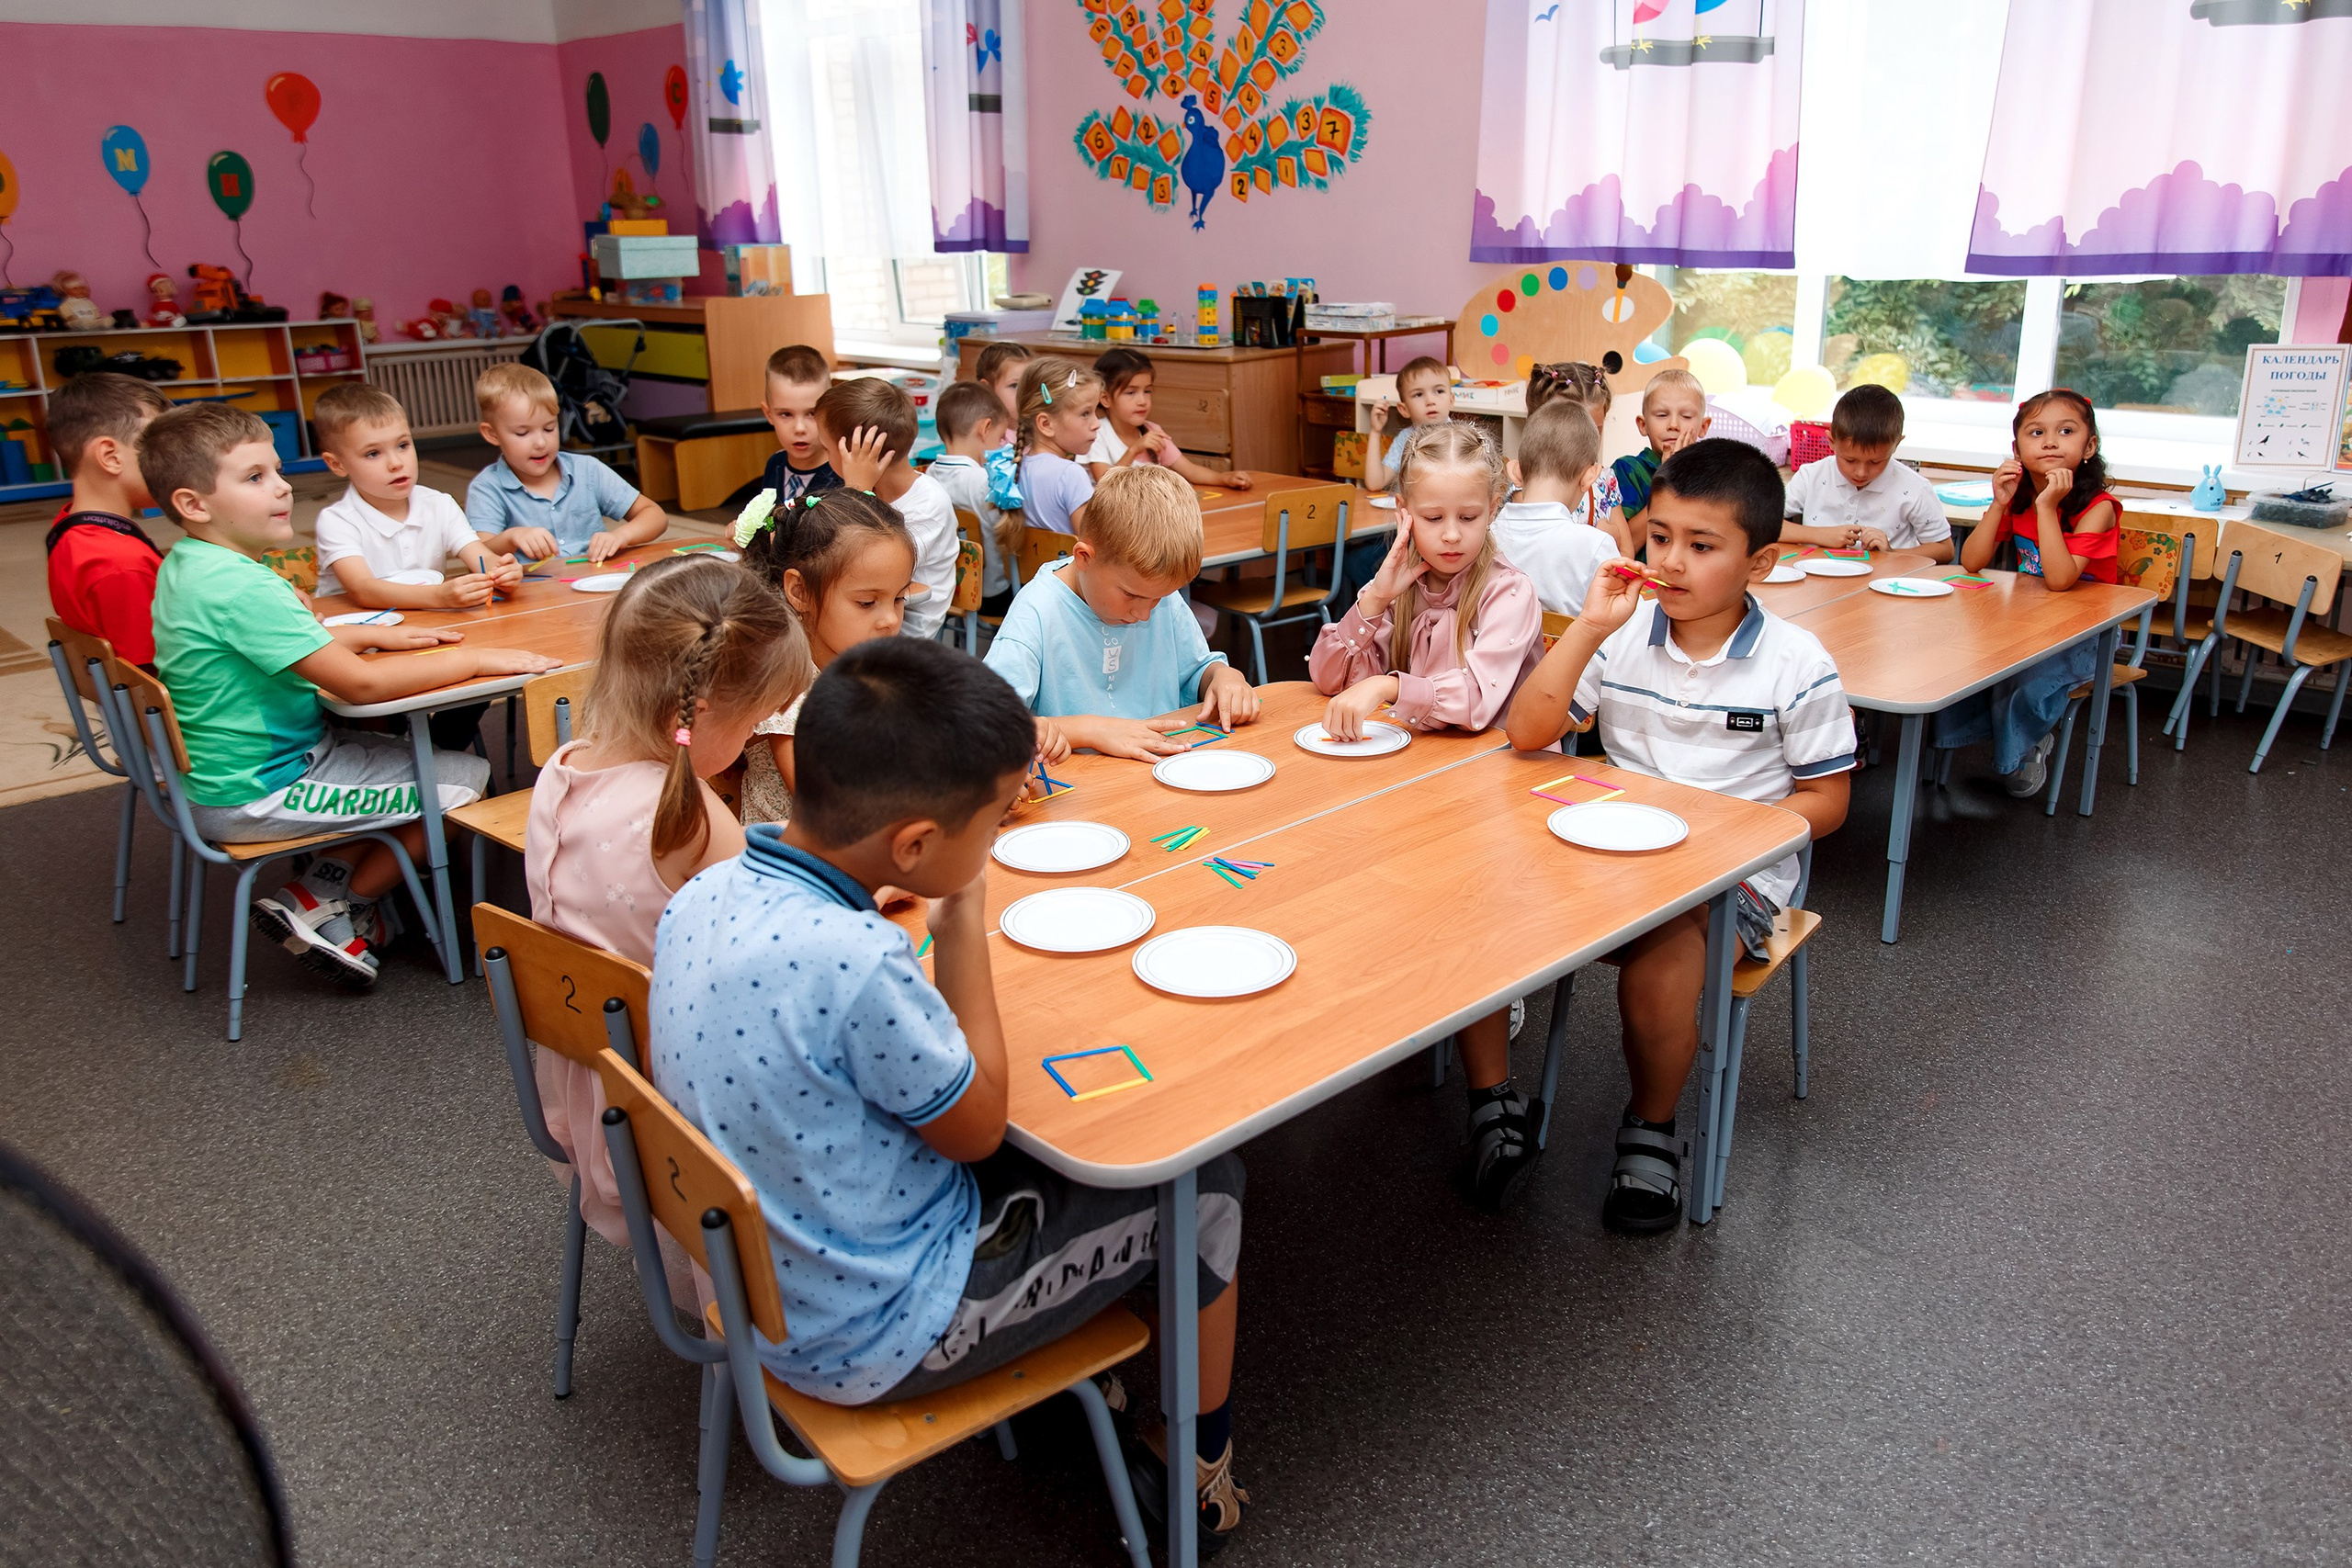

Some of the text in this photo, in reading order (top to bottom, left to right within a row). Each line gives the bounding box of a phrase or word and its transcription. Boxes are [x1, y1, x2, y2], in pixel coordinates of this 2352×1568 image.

[1126, 11, 1136, 28] 3
[1170, 30, 1176, 42] 1
[1243, 36, 1249, 51] 1
[1148, 47, 1158, 60] 2
[1199, 47, 1207, 62] 4
[1275, 38, 1286, 57] 3
[1170, 79, 1180, 95] 2
[1207, 90, 1216, 104] 5
[1246, 90, 1253, 107] 4
[1302, 111, 1311, 130] 3
[1143, 121, 1154, 140] 2
[1249, 129, 1258, 147] 4
[1326, 120, 1340, 141] 7
[1094, 131, 1104, 150] 6
[1117, 163, 1123, 177] 1
[1284, 164, 1289, 178] 1
[1159, 183, 1167, 199] 3
[1237, 178, 1246, 195] 2
[2263, 355, 2340, 365] КАЛЕНДАРЬ
[2270, 371, 2326, 380] ПОГОДЫ
[1306, 504, 1316, 520] 2
[1033, 542, 1038, 557] 1
[2274, 551, 2283, 564] 1
[561, 974, 582, 1014] 2
[668, 1156, 687, 1202] 2
